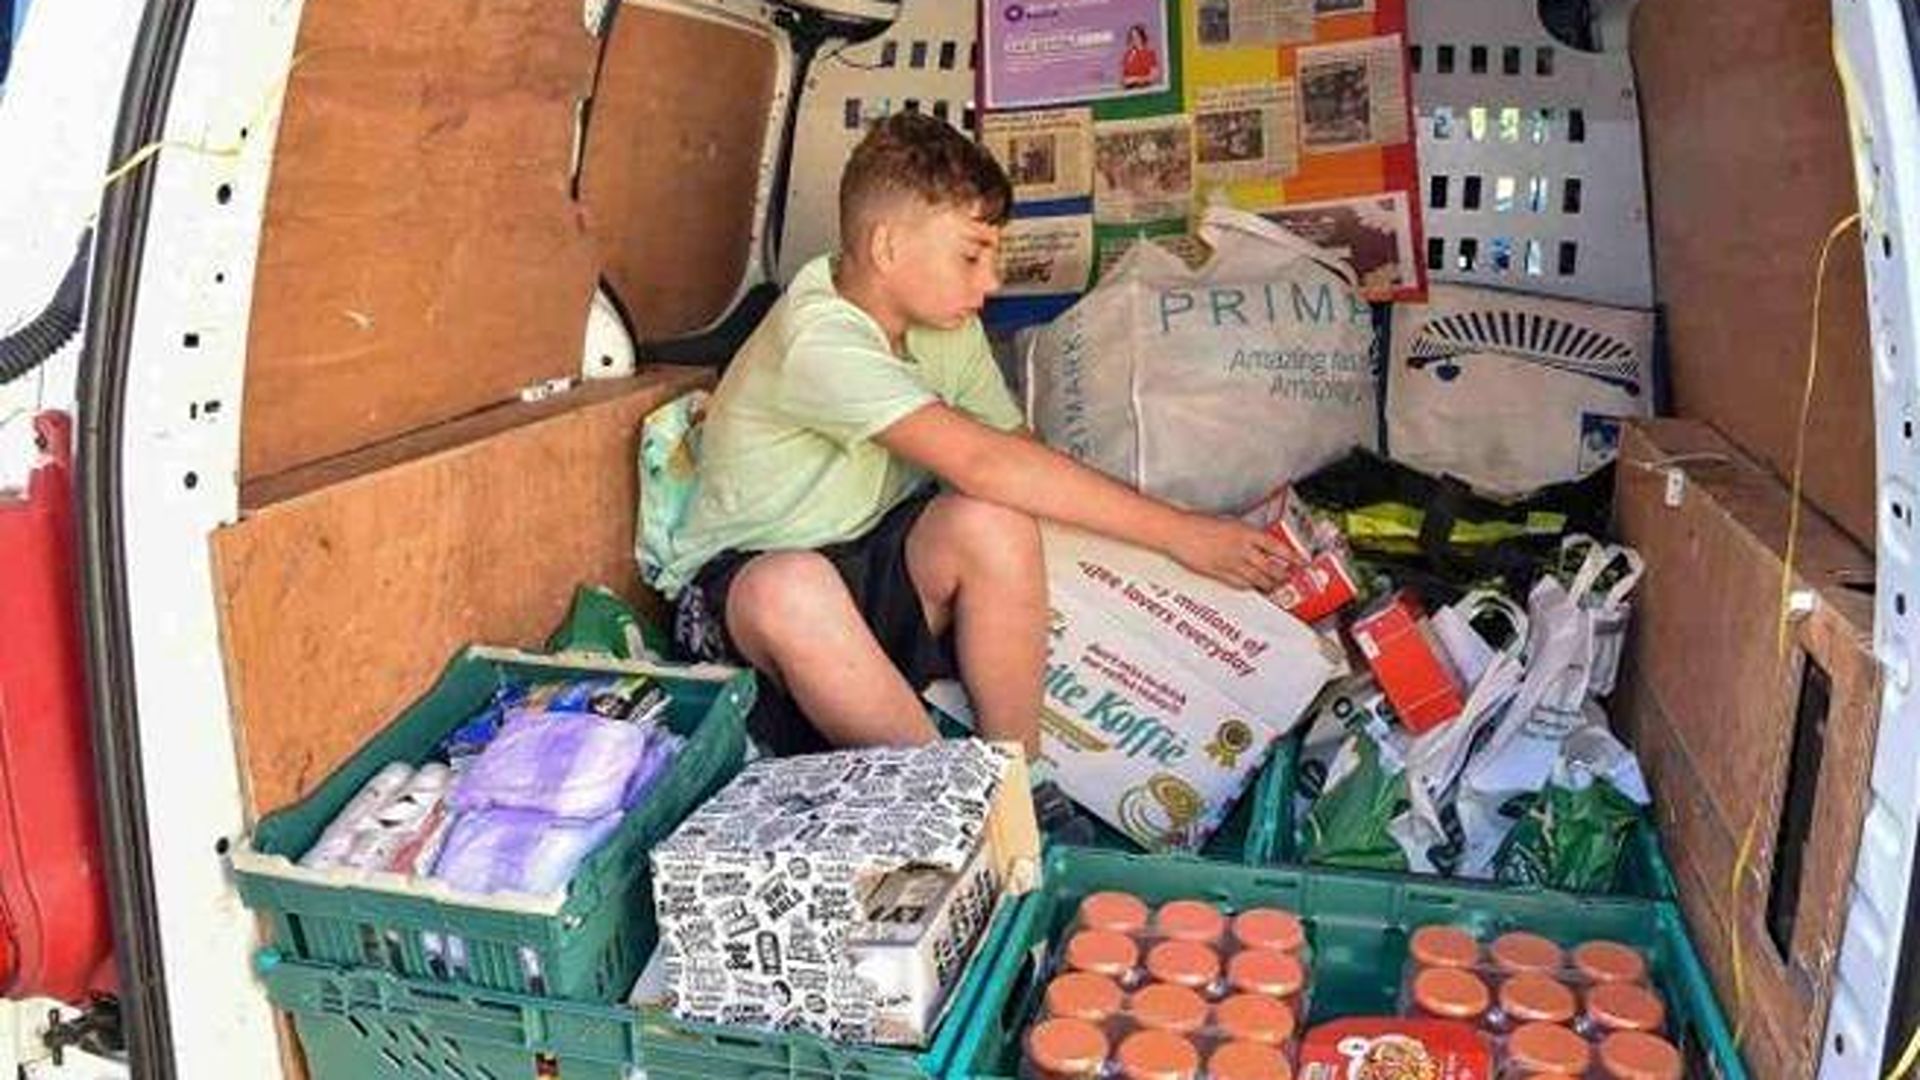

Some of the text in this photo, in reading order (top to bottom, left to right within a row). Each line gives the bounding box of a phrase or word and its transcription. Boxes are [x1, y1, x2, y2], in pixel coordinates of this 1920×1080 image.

[1122, 582, 1178, 624] lovers
[1174, 619, 1257, 678] everyday
[1172, 592, 1243, 643] millions
[1243, 637, 1270, 659] of
[1082, 691, 1188, 766] Koffie
